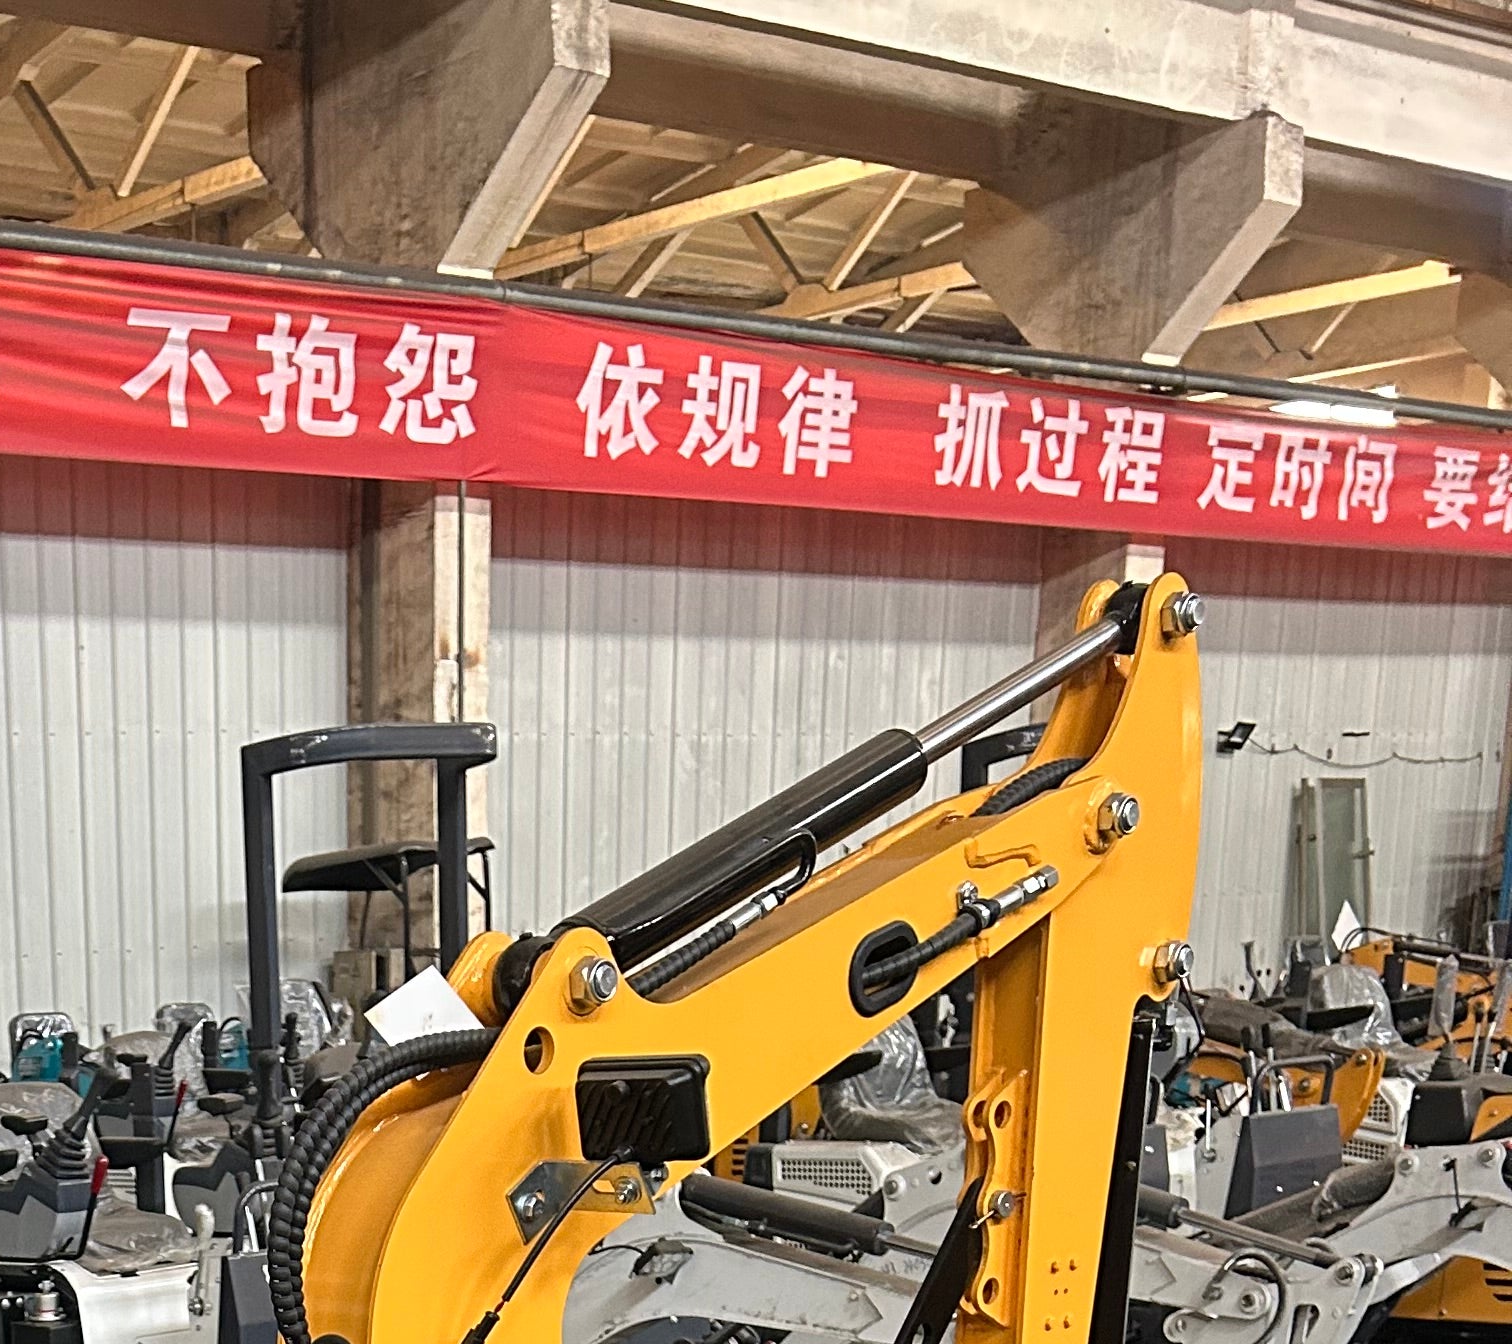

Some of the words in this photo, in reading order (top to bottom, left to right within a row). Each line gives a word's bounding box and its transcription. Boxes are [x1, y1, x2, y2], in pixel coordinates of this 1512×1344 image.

[119, 307, 478, 446] 不抱怨
[575, 341, 858, 479] 依规律
[933, 383, 1165, 504] 抓过程
[1196, 422, 1398, 524] 定时间
